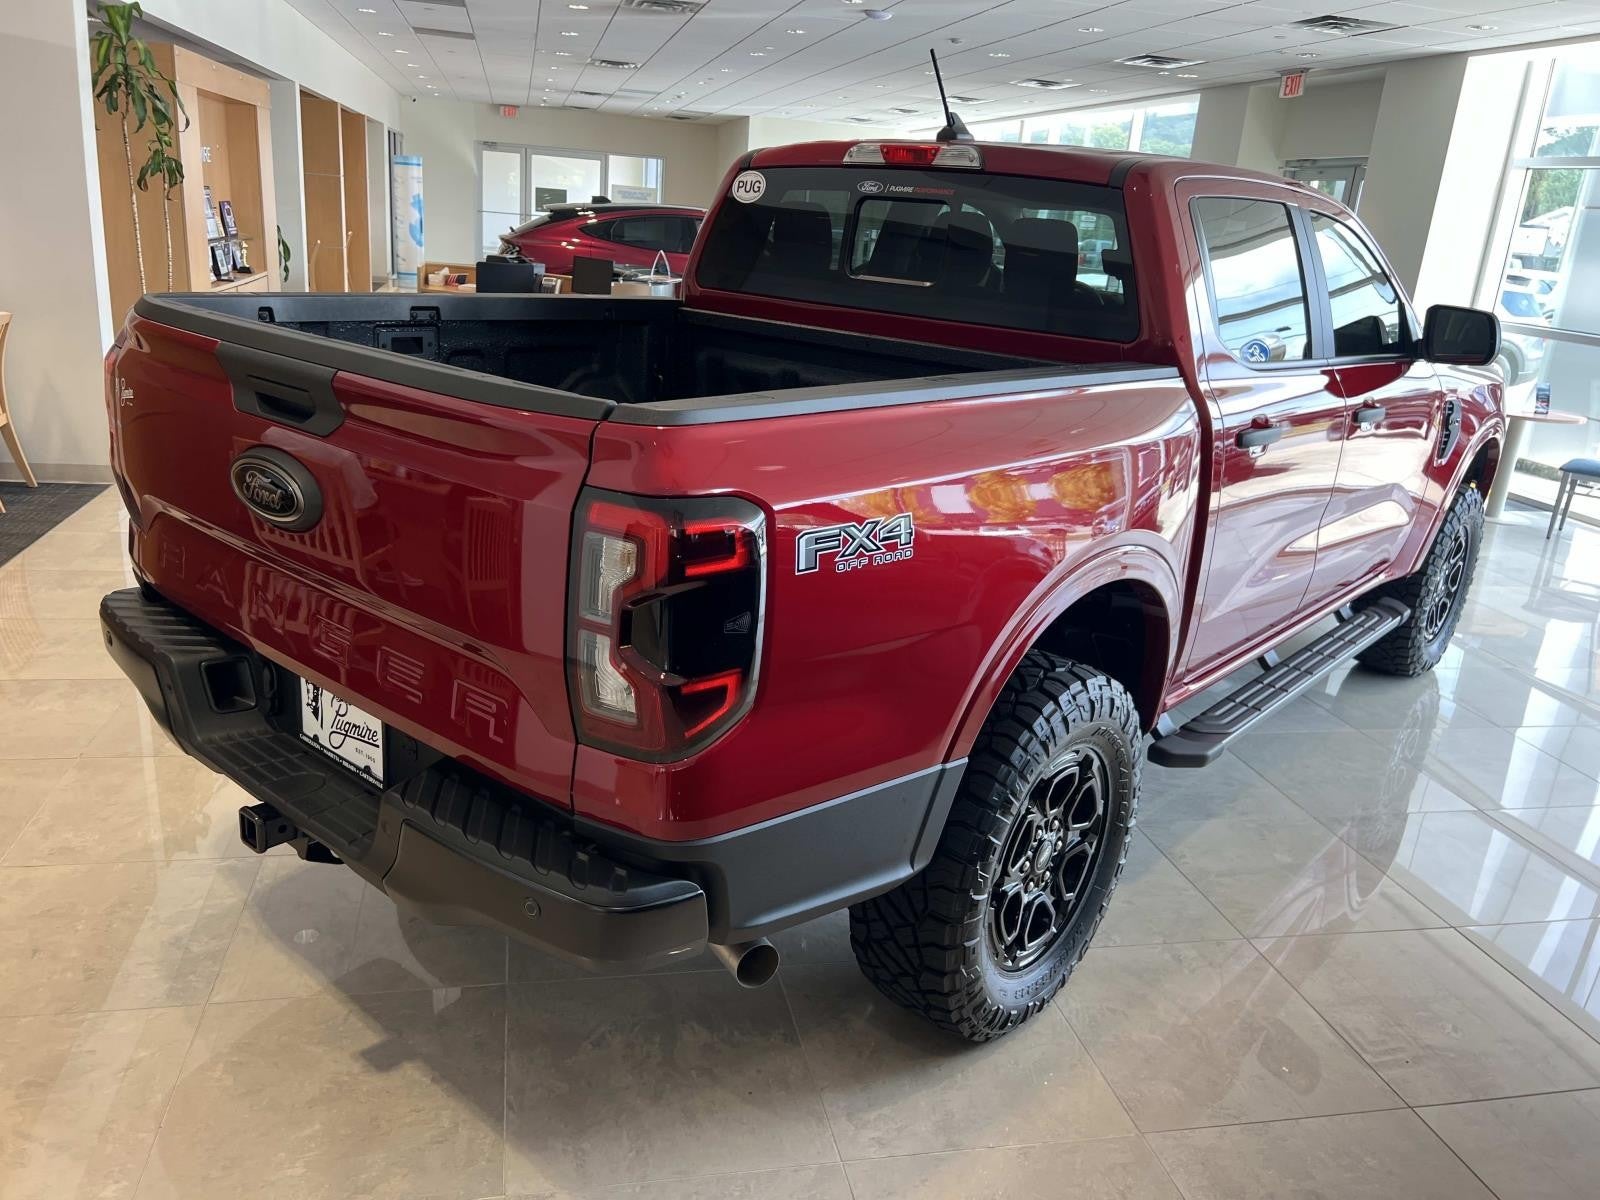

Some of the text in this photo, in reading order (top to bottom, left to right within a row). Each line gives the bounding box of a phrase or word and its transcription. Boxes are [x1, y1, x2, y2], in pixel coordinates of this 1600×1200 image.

[1284, 75, 1302, 96] EXIT
[737, 180, 762, 193] PUG
[242, 470, 286, 510] Ford
[796, 512, 915, 575] FX4
[836, 549, 913, 573] OFF ROAD
[161, 540, 508, 744] RANGER
[329, 695, 380, 749] Pugmire
